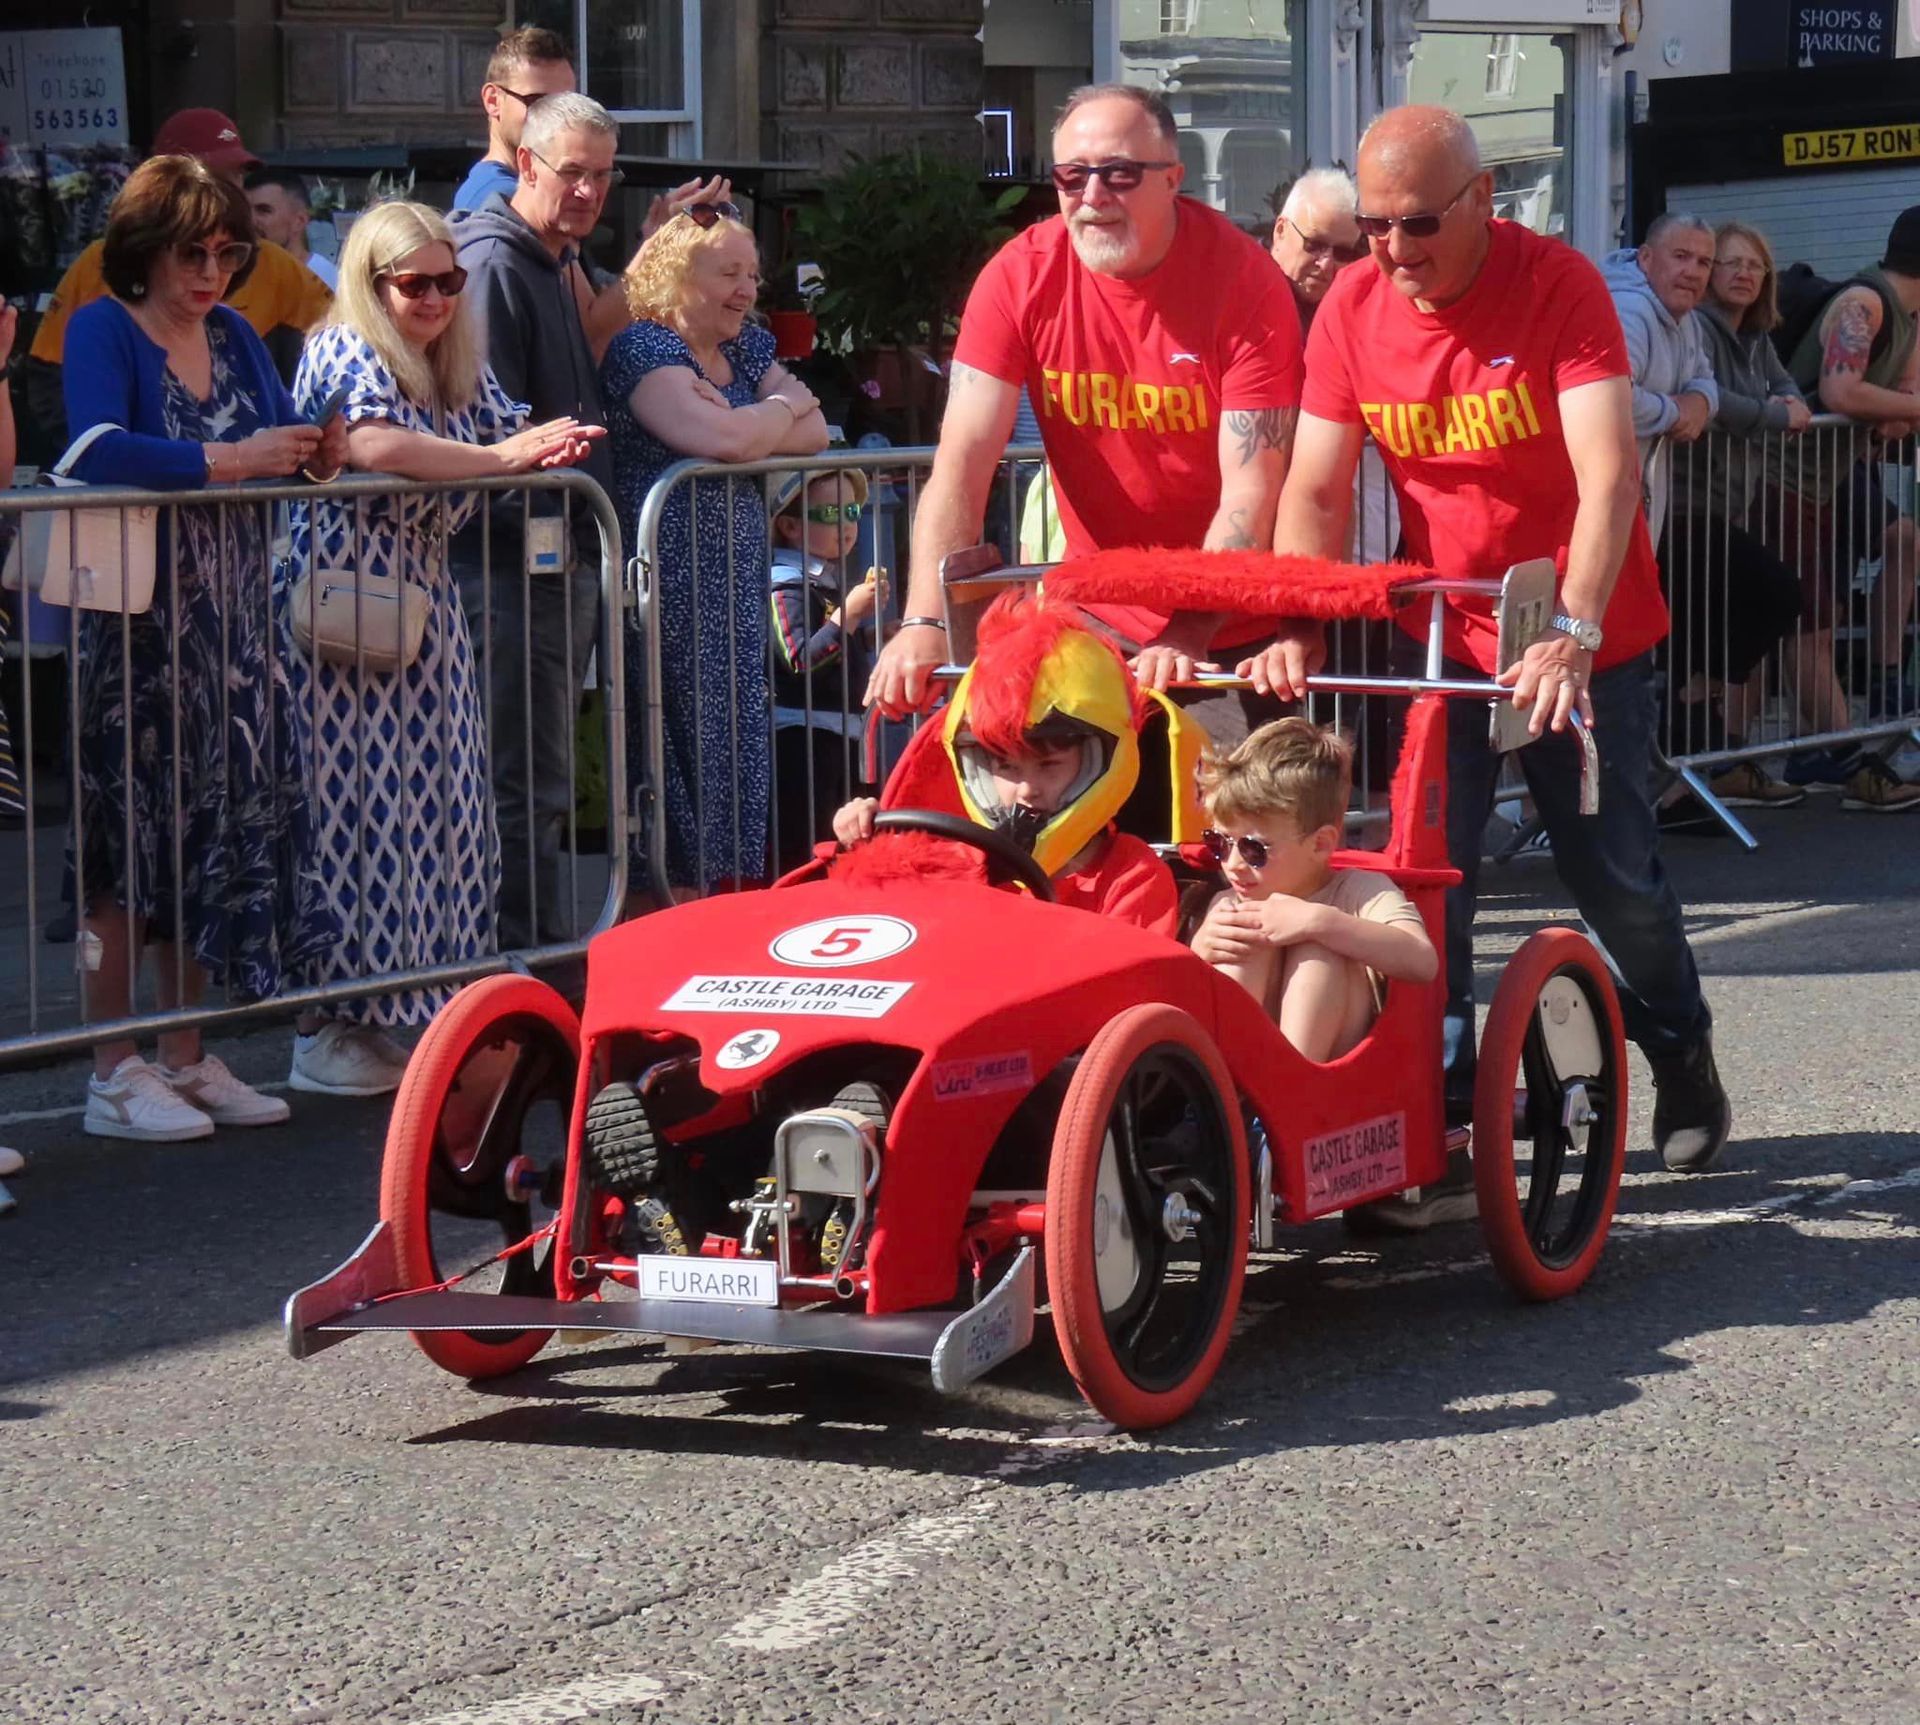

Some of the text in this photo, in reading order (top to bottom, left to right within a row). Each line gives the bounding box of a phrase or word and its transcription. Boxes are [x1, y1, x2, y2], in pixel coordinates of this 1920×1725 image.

[1800, 8, 1883, 30] SHOPS &
[1800, 31, 1881, 54] PARKING
[35, 108, 118, 130] 563563
[1794, 134, 1856, 161] DJ57
[1864, 128, 1912, 156] RON
[1042, 367, 1209, 434] FURARRI
[810, 928, 873, 958] 5
[696, 980, 895, 1001] CASTLE GARAGE
[716, 997, 838, 1011] (ASHBY) LTD
[1310, 1119, 1399, 1174] CASTLE GARAGE
[657, 1269, 759, 1297] FURARRI
